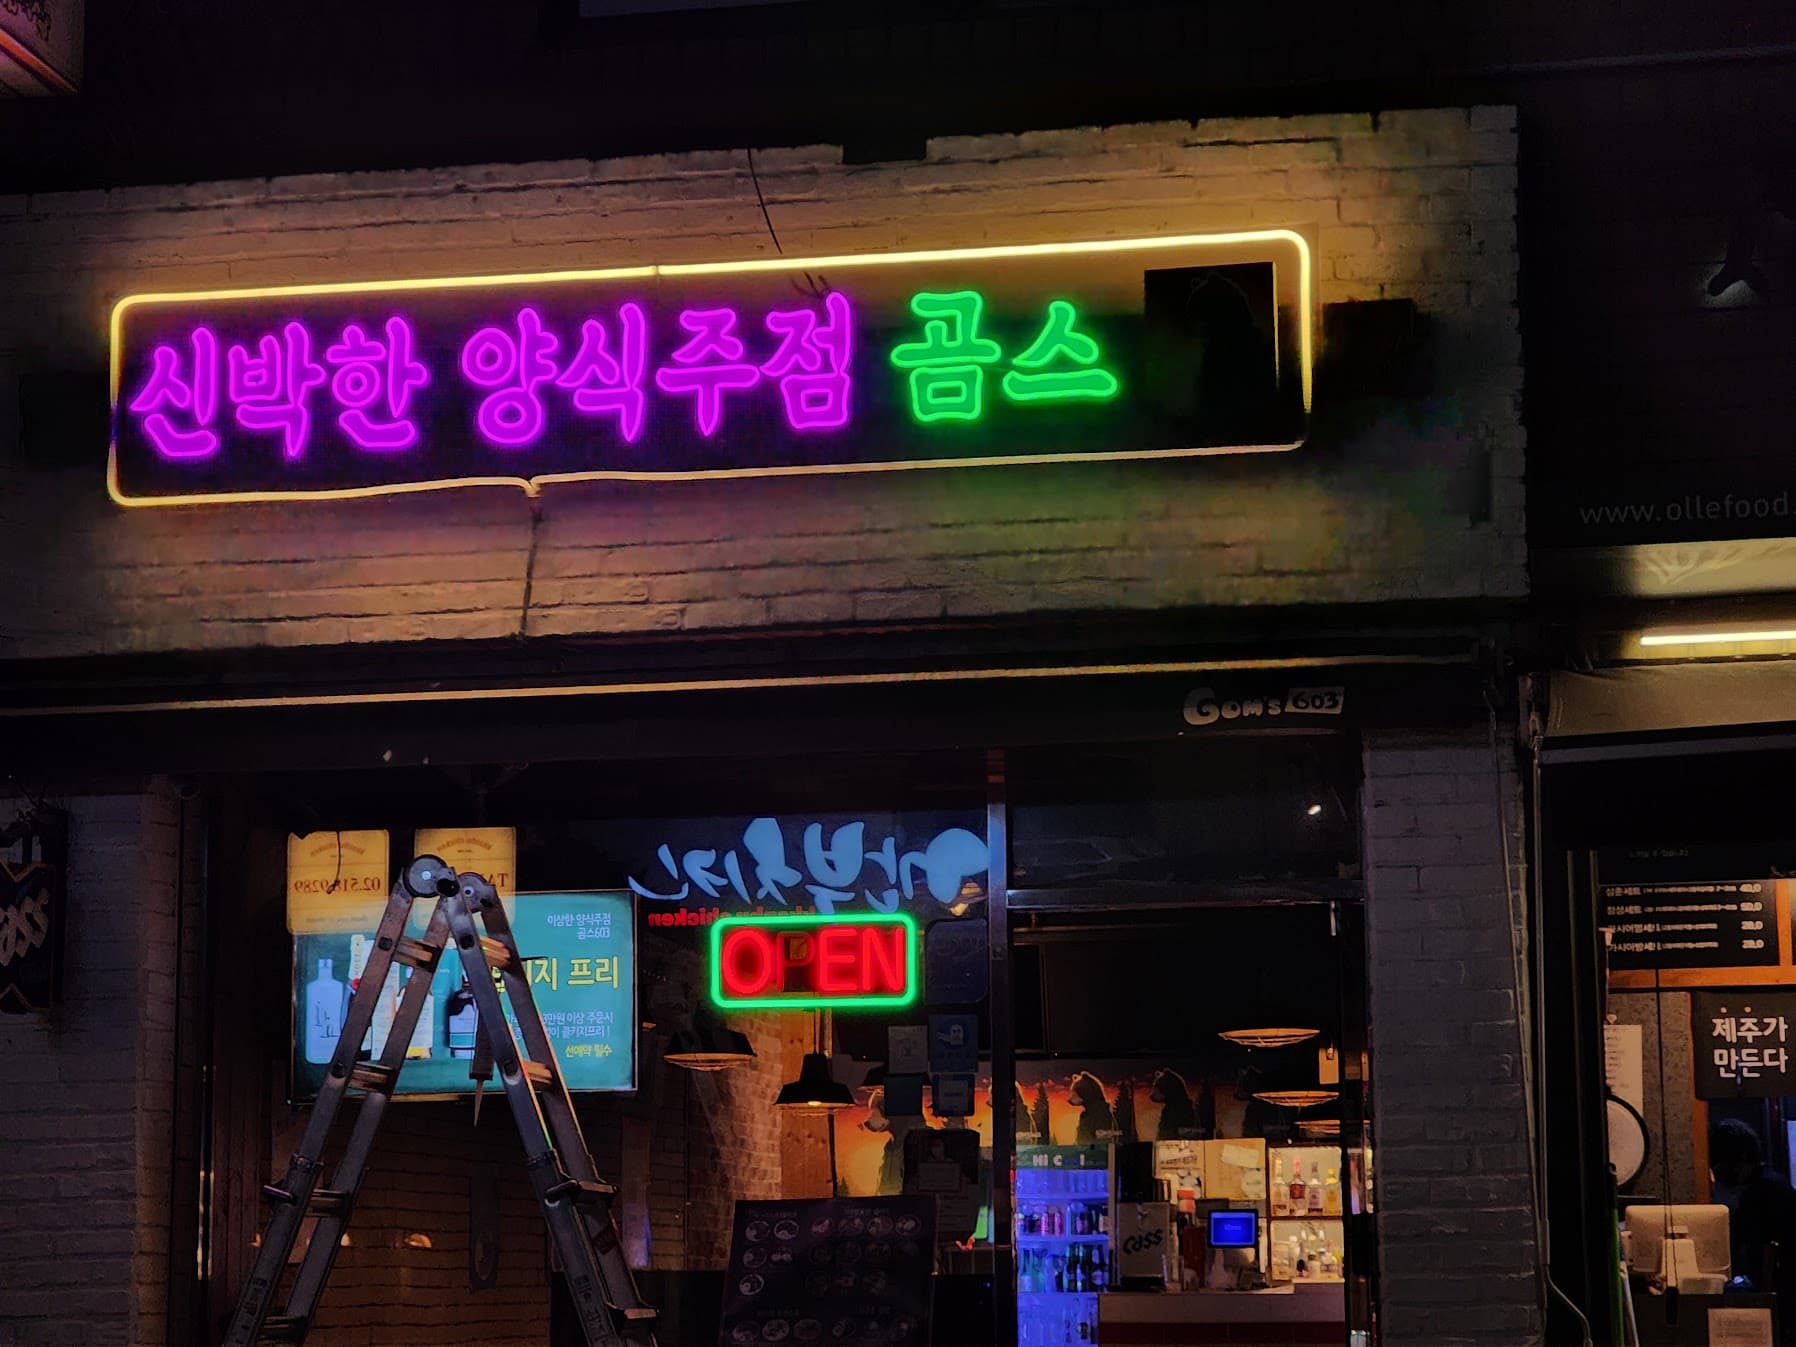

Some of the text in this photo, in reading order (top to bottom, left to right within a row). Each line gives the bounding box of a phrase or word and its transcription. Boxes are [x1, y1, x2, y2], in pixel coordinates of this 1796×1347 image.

[129, 289, 1120, 460] 신박한 양식주점 곰스
[1291, 688, 1340, 712] 603
[547, 912, 612, 928] 이상한 양식주점
[577, 927, 611, 940] 곰스603
[567, 957, 619, 989] 프리
[722, 926, 906, 994] OPEN
[567, 1012, 585, 1025] 이상
[588, 1011, 614, 1024] 주문시
[1711, 1016, 1788, 1044] 제주가
[1714, 1048, 1788, 1078] 만든다
